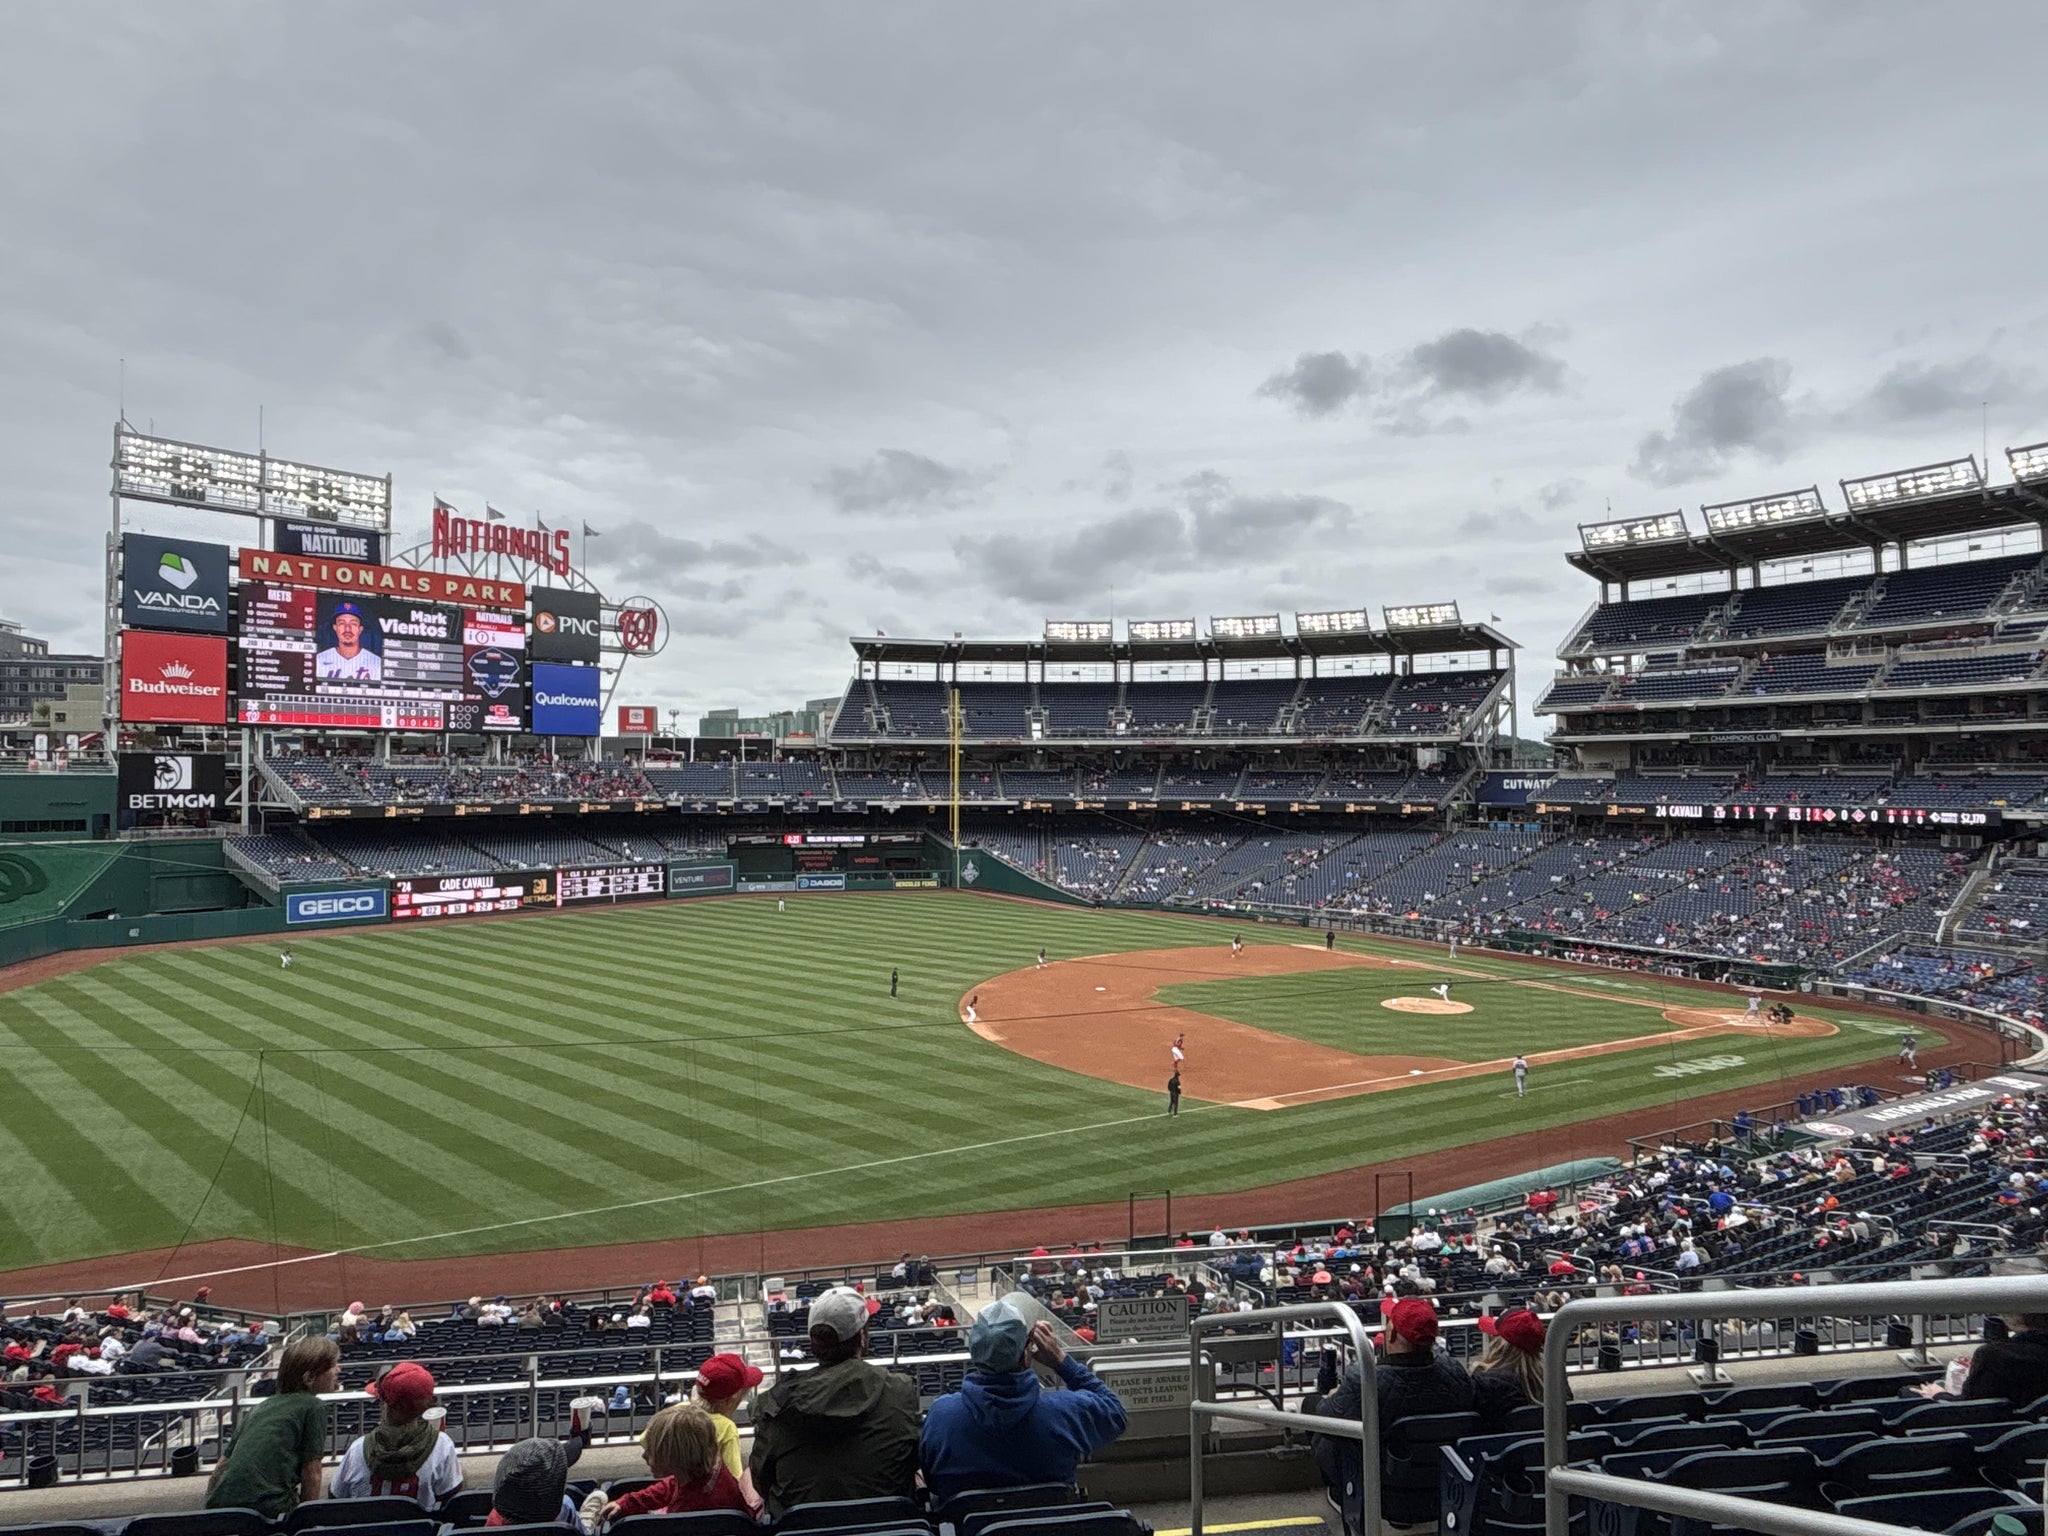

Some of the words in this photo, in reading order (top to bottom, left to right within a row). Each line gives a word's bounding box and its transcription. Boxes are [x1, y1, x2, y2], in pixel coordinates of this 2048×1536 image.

[287, 524, 312, 532] SHOW
[302, 534, 368, 556] NATITUDE
[432, 508, 570, 577] NATIONALS
[252, 557, 430, 593] NATIONALS
[445, 583, 513, 602] PARK
[134, 589, 221, 611] VANDA
[268, 589, 292, 602] METS
[410, 610, 447, 625] Mark
[476, 612, 512, 624] NATIONALS
[378, 618, 447, 638] Vientos
[558, 616, 600, 636] PNC
[129, 678, 220, 696] Budweiser
[535, 692, 599, 706] Qualcomm
[129, 794, 216, 808] BETMGM
[1656, 806, 1667, 817] 24
[1669, 806, 1702, 817] CAVALLI
[1841, 809, 1848, 820] 0
[1871, 810, 1878, 821] 0
[440, 879, 461, 891] CADE
[463, 876, 494, 888] CAVALLI
[674, 875, 704, 884] VENTURE
[523, 894, 556, 903] BETMGM
[298, 896, 374, 916] GEICO
[1864, 1096, 1958, 1122] NATIONALS
[1108, 1301, 1177, 1316] CAUTION
[1111, 1378, 1140, 1386] PLEASE
[1118, 1387, 1154, 1396] OBJECTS
[1155, 1385, 1188, 1393] LEAVING
